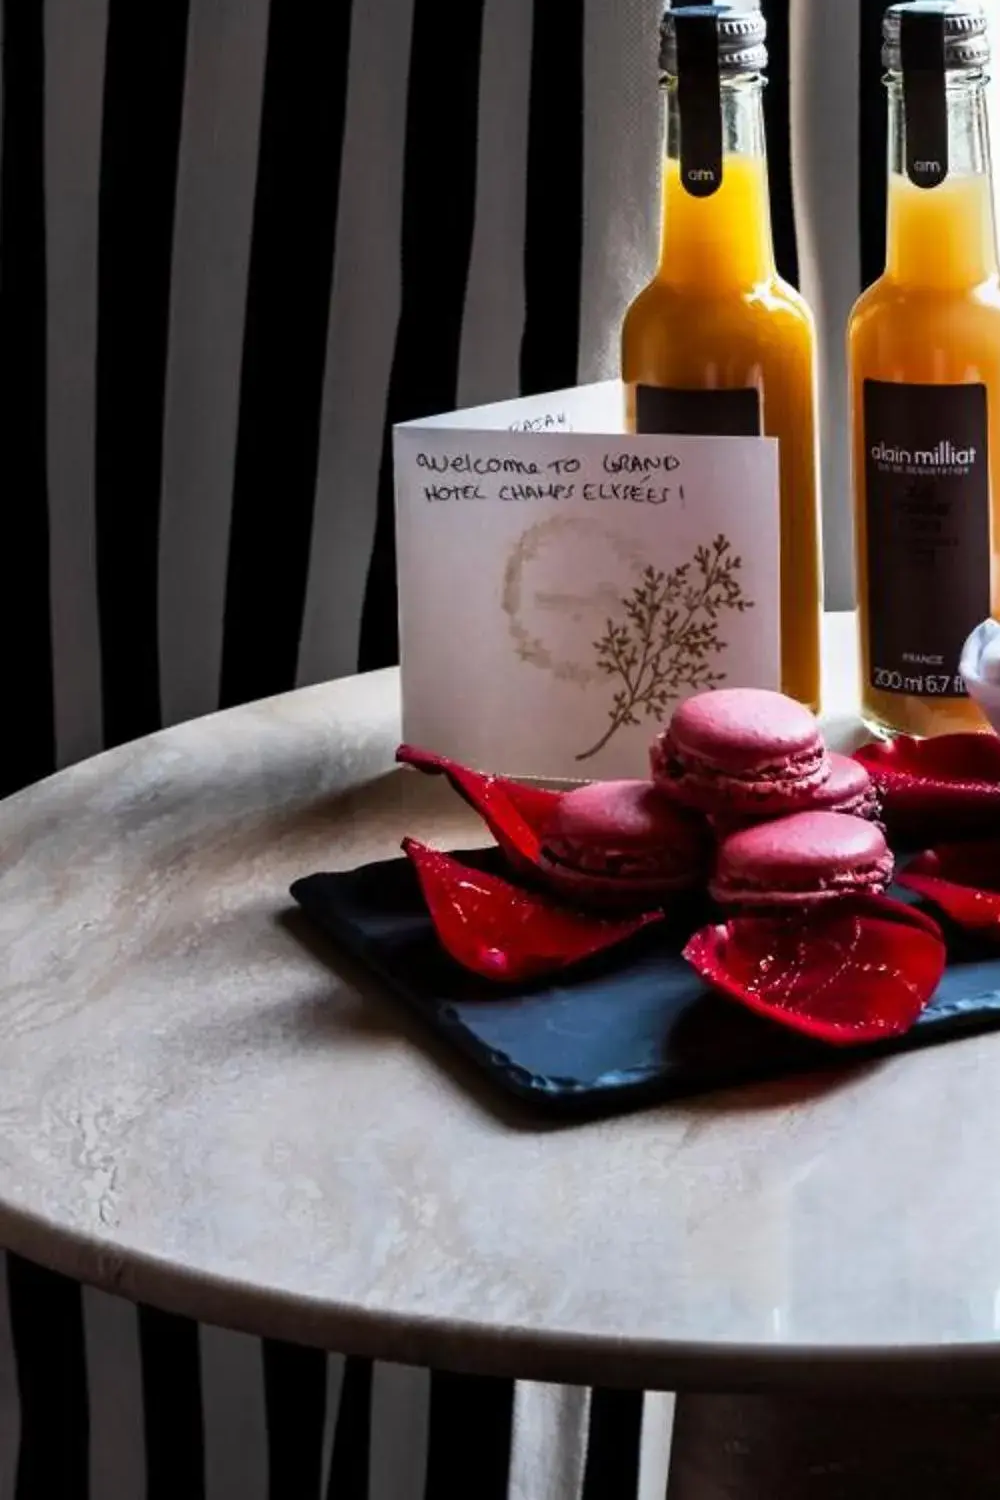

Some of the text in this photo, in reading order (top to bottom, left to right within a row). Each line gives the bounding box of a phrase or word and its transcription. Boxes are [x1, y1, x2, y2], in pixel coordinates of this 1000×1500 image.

[688, 167, 715, 181] am
[914, 159, 942, 173] am
[871, 440, 977, 465] alain milliat
[547, 458, 581, 474] TO
[603, 453, 681, 473] GRAND
[423, 483, 487, 503] HOTEL
[498, 482, 575, 502] CHAMPS
[874, 667, 902, 689] 200
